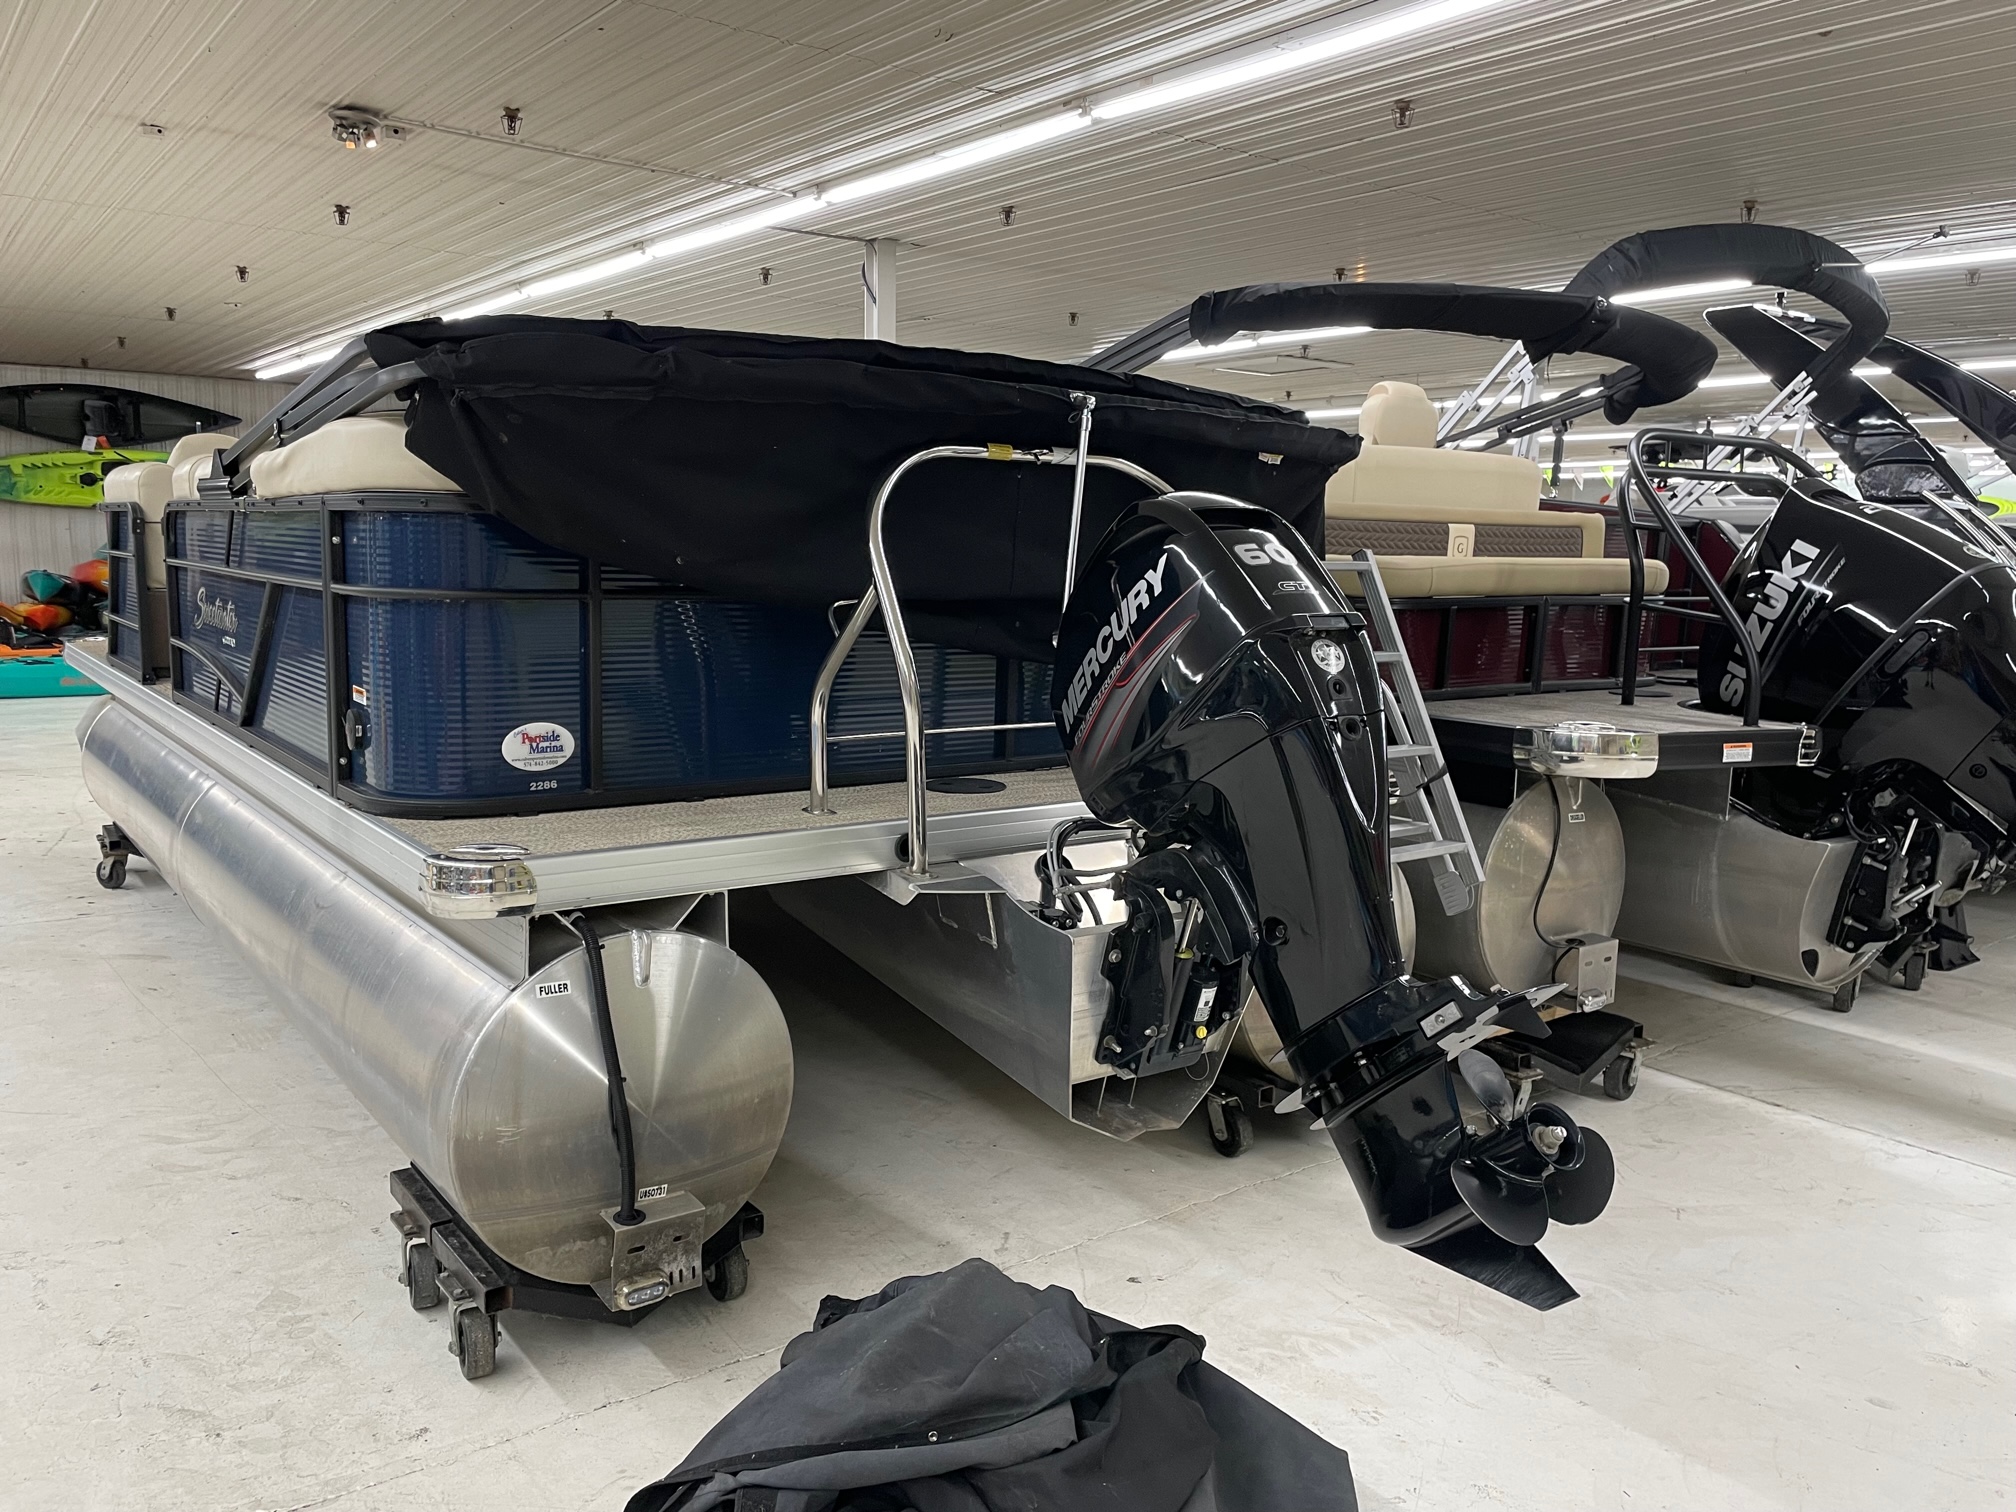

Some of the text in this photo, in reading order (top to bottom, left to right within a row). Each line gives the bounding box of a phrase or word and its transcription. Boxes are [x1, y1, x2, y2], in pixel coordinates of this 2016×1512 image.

[1233, 542, 1299, 567] 60
[1061, 552, 1168, 734] MERCURY
[521, 731, 560, 744] Portside
[529, 743, 564, 754] Marina
[529, 780, 558, 791] 2286
[539, 983, 569, 996] FULLER
